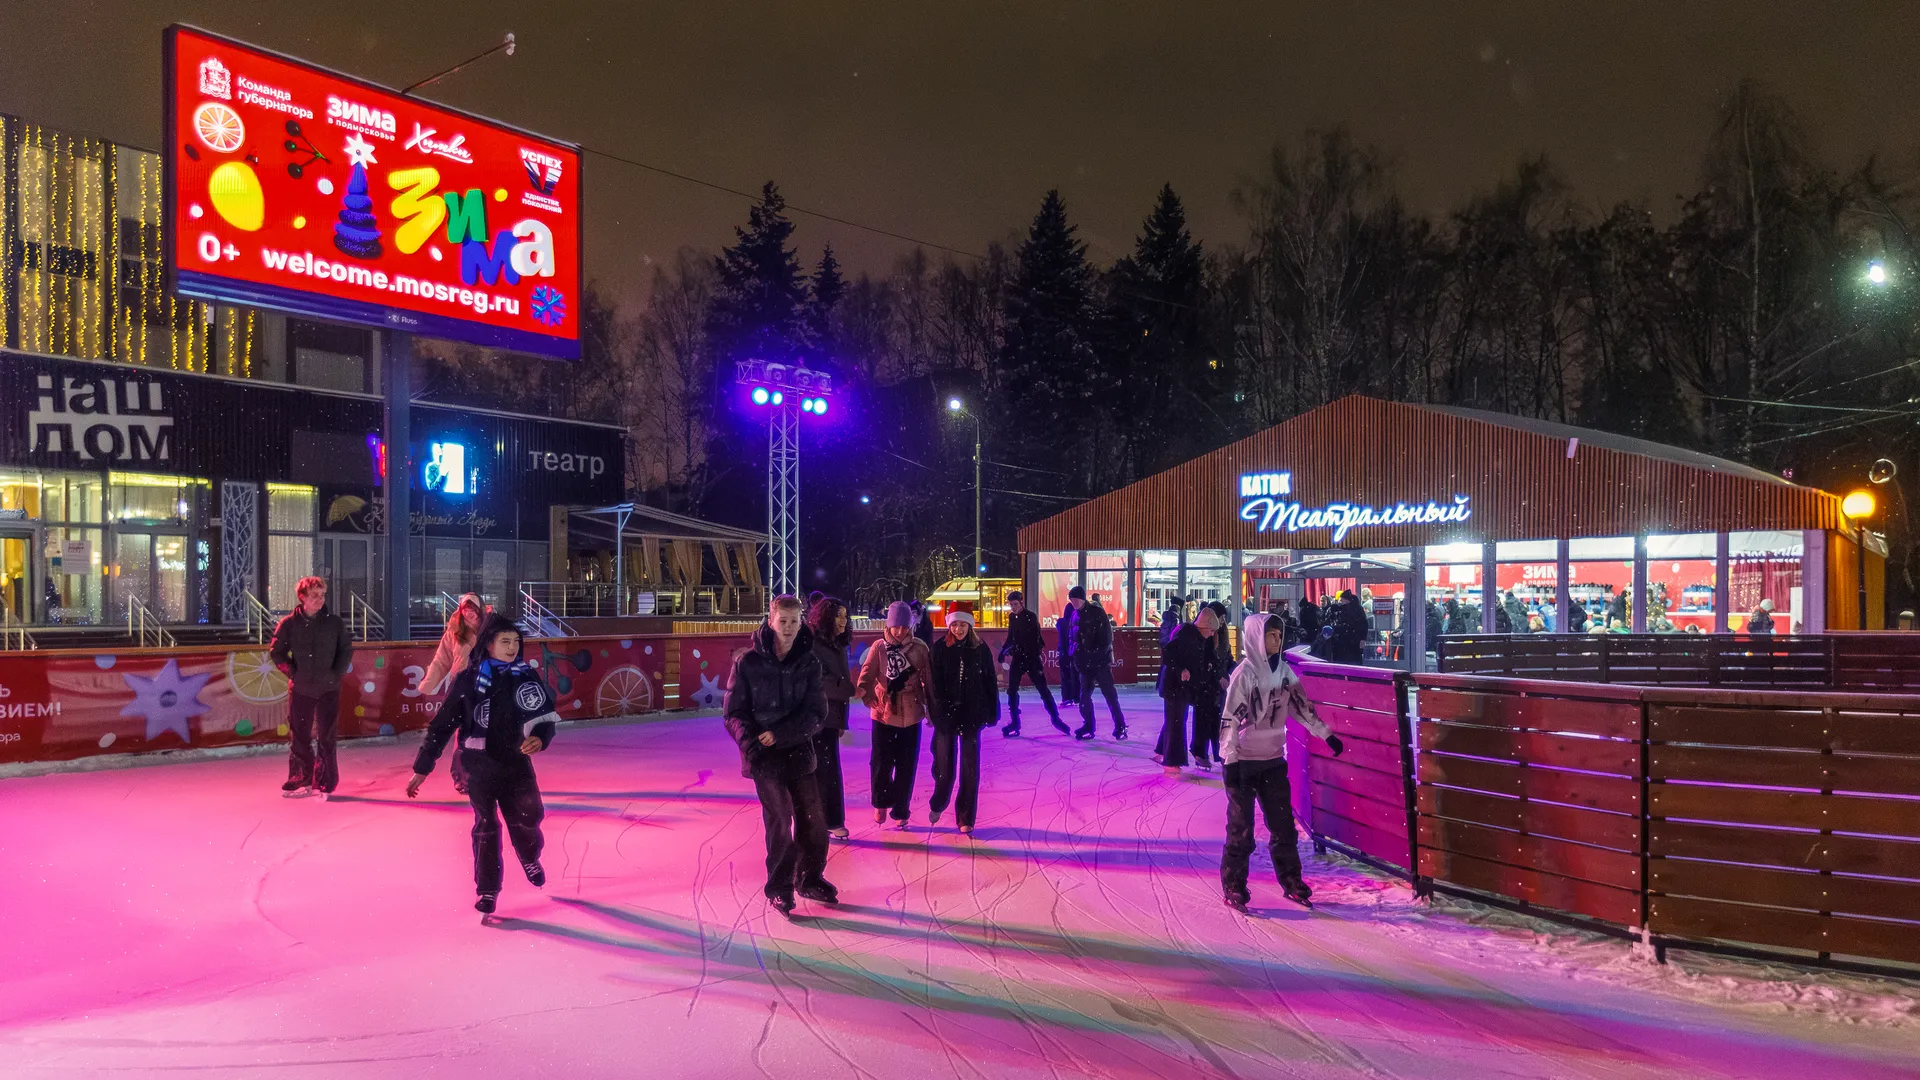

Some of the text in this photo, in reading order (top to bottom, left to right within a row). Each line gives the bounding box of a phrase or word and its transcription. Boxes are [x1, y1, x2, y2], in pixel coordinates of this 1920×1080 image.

[238, 76, 291, 101] Команда
[238, 90, 314, 120] губернатора
[335, 119, 396, 141] подмосковье
[405, 122, 474, 164] Химки
[520, 148, 562, 170] УСПЕХ
[521, 198, 562, 214] ПОКОЛЕНИЙ
[199, 235, 241, 262] 0+
[263, 247, 519, 316] welcome.mosreg.ru
[529, 449, 605, 479] театр
[1241, 473, 1291, 497] КАТОК
[1241, 496, 1470, 543] Театральный
